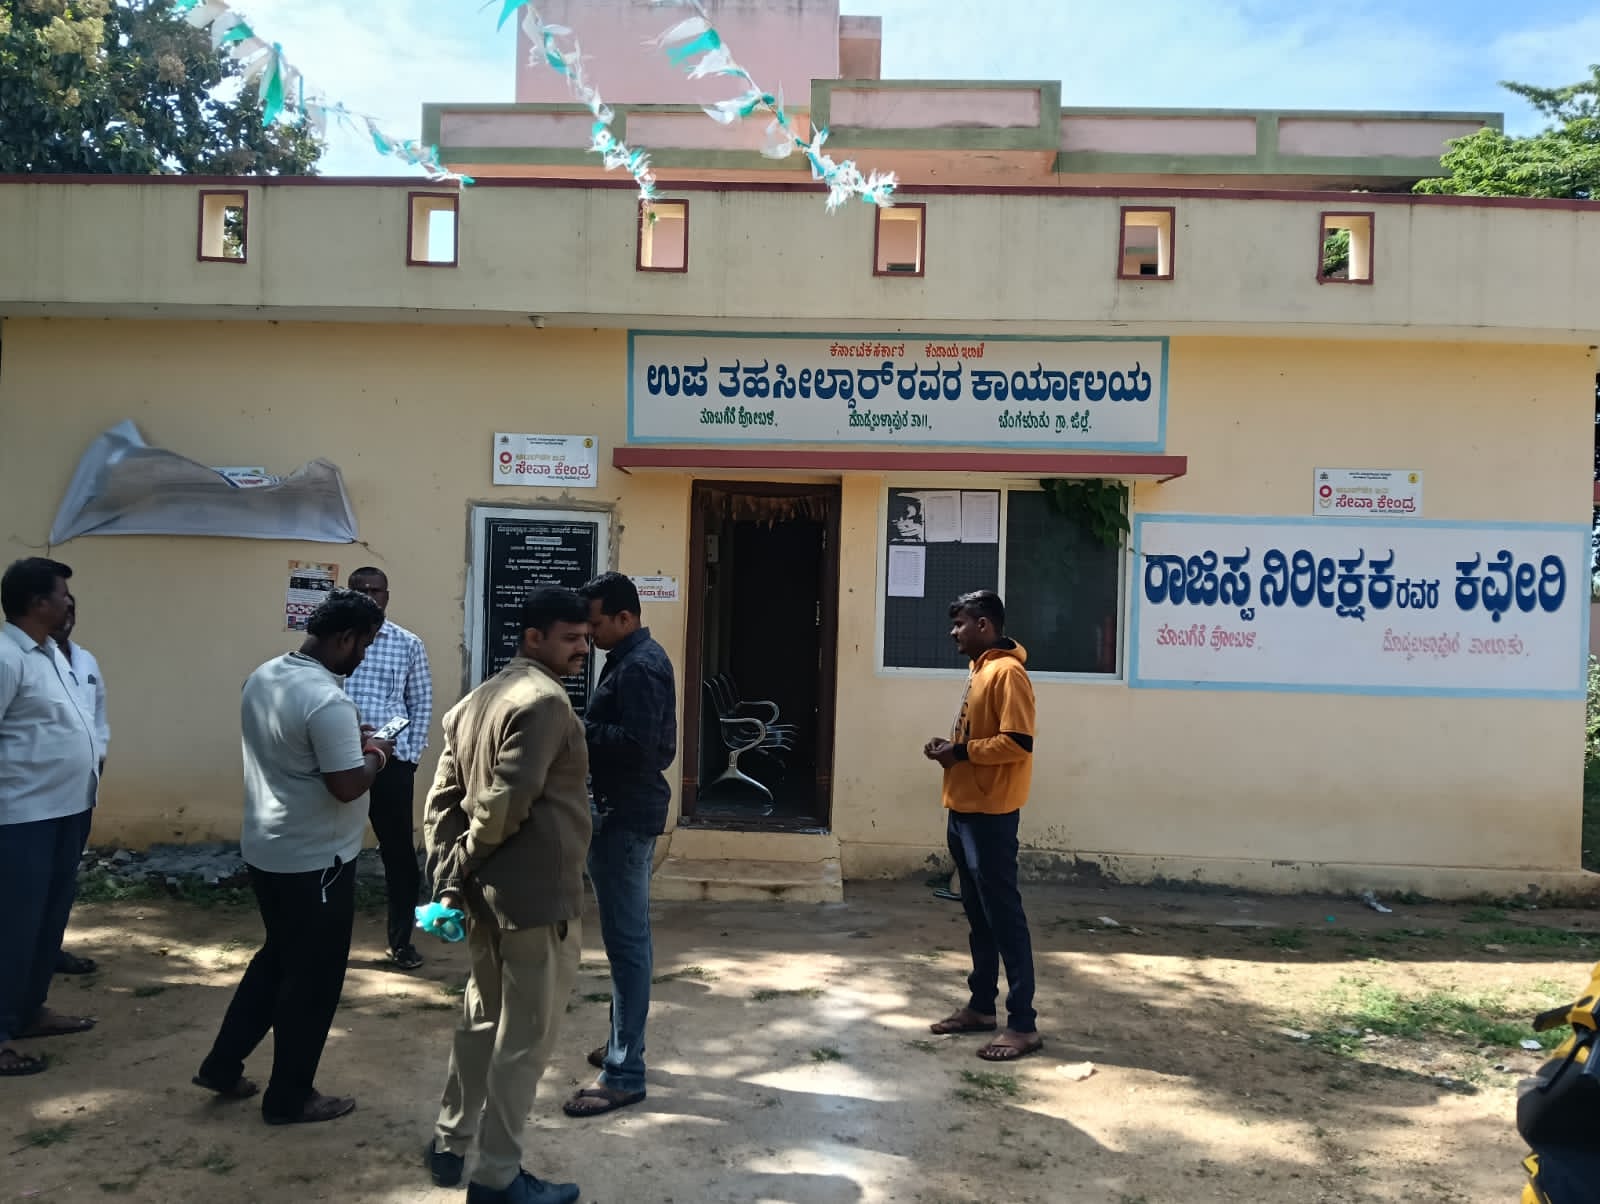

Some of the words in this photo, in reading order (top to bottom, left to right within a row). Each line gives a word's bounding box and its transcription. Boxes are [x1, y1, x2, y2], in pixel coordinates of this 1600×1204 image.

[647, 357, 708, 397] ಉಪ
[971, 361, 1152, 402] ಕಾರ್ಯಾಲಯ
[998, 409, 1050, 428] ಬೆಂಗಳೂರು
[515, 460, 551, 475] ಸೇವಾ
[554, 462, 591, 480] ಕೇಂದ್ರ
[1335, 494, 1373, 508] ಸೇವಾ
[1377, 495, 1416, 513] ಕೇಂದ್ರ
[1455, 550, 1566, 623] ಕಛೇರಿ
